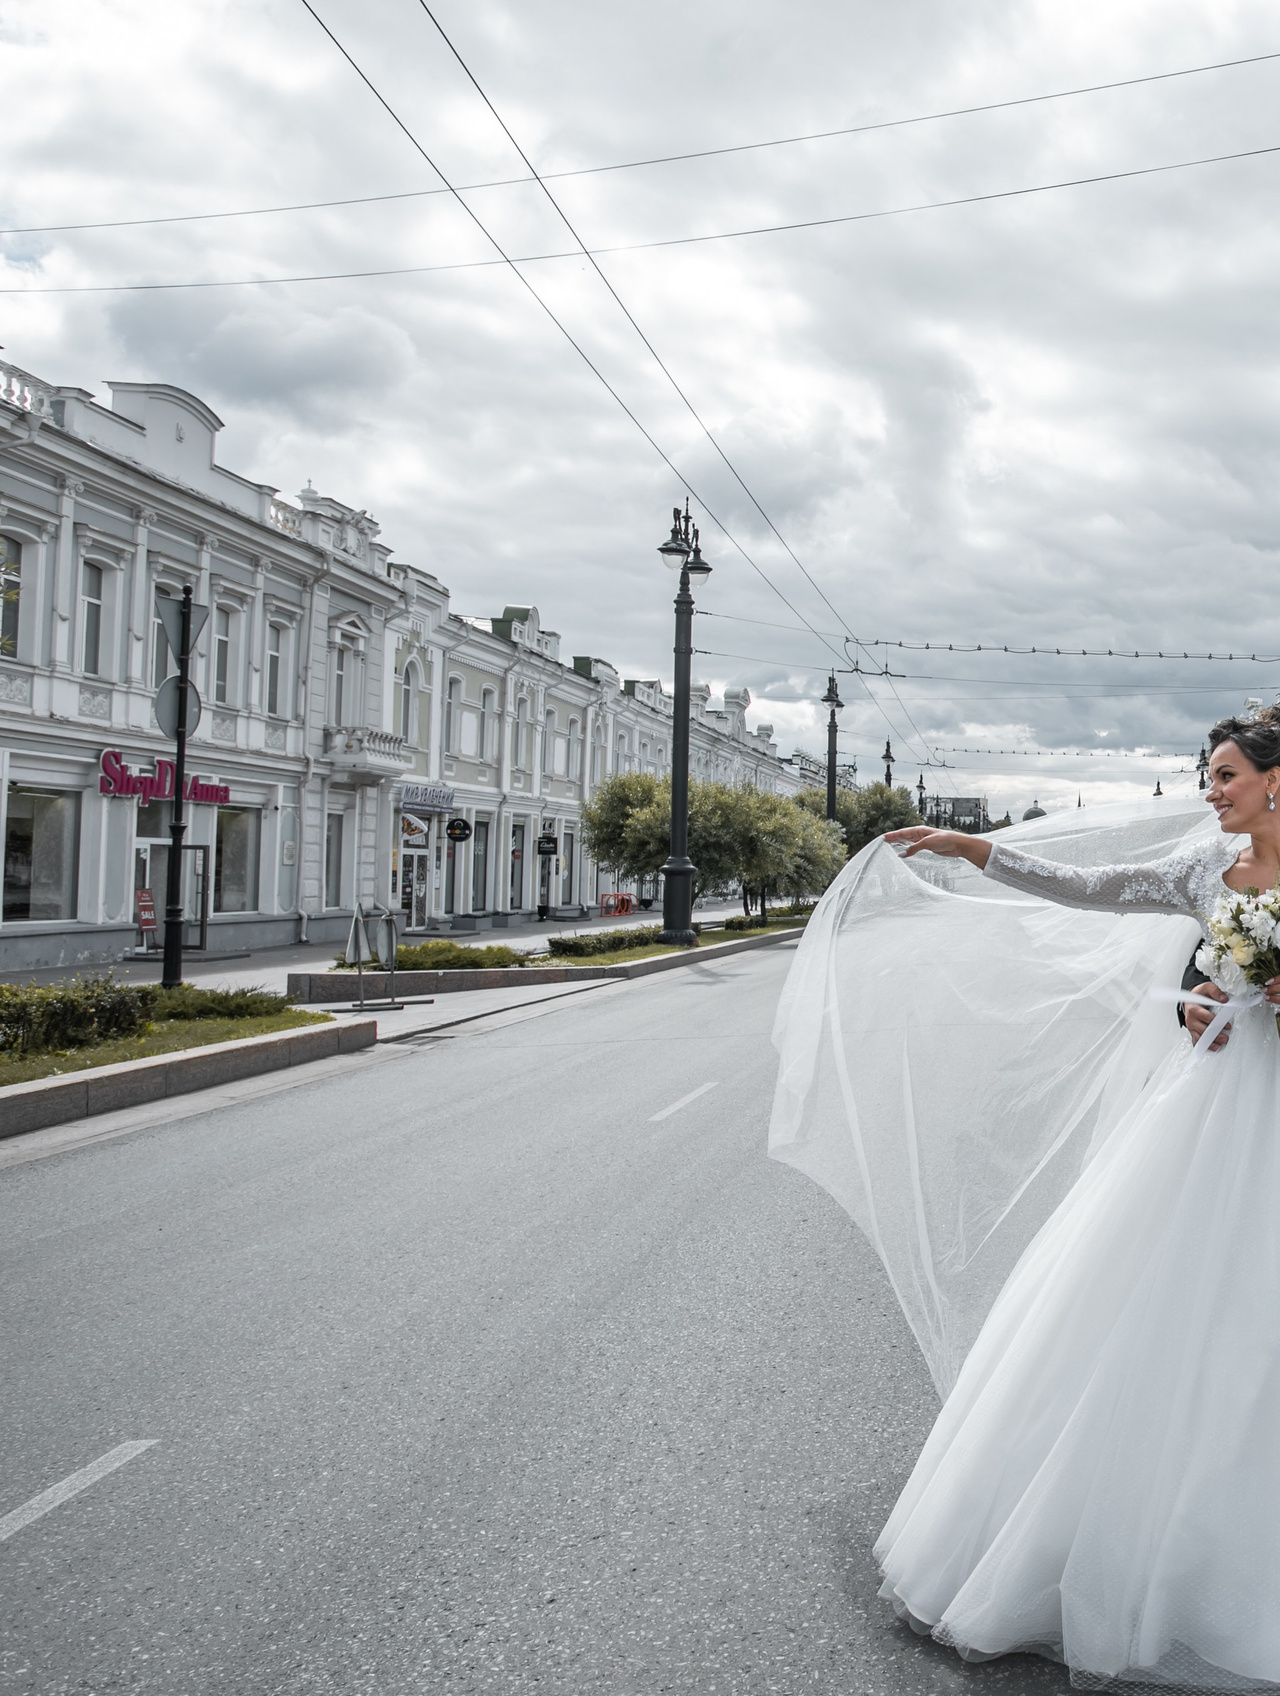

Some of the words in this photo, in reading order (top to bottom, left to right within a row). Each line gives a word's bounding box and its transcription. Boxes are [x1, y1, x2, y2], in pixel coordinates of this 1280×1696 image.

[99, 748, 157, 807] Shop
[187, 774, 230, 804] Anna
[141, 910, 155, 920] SALE
